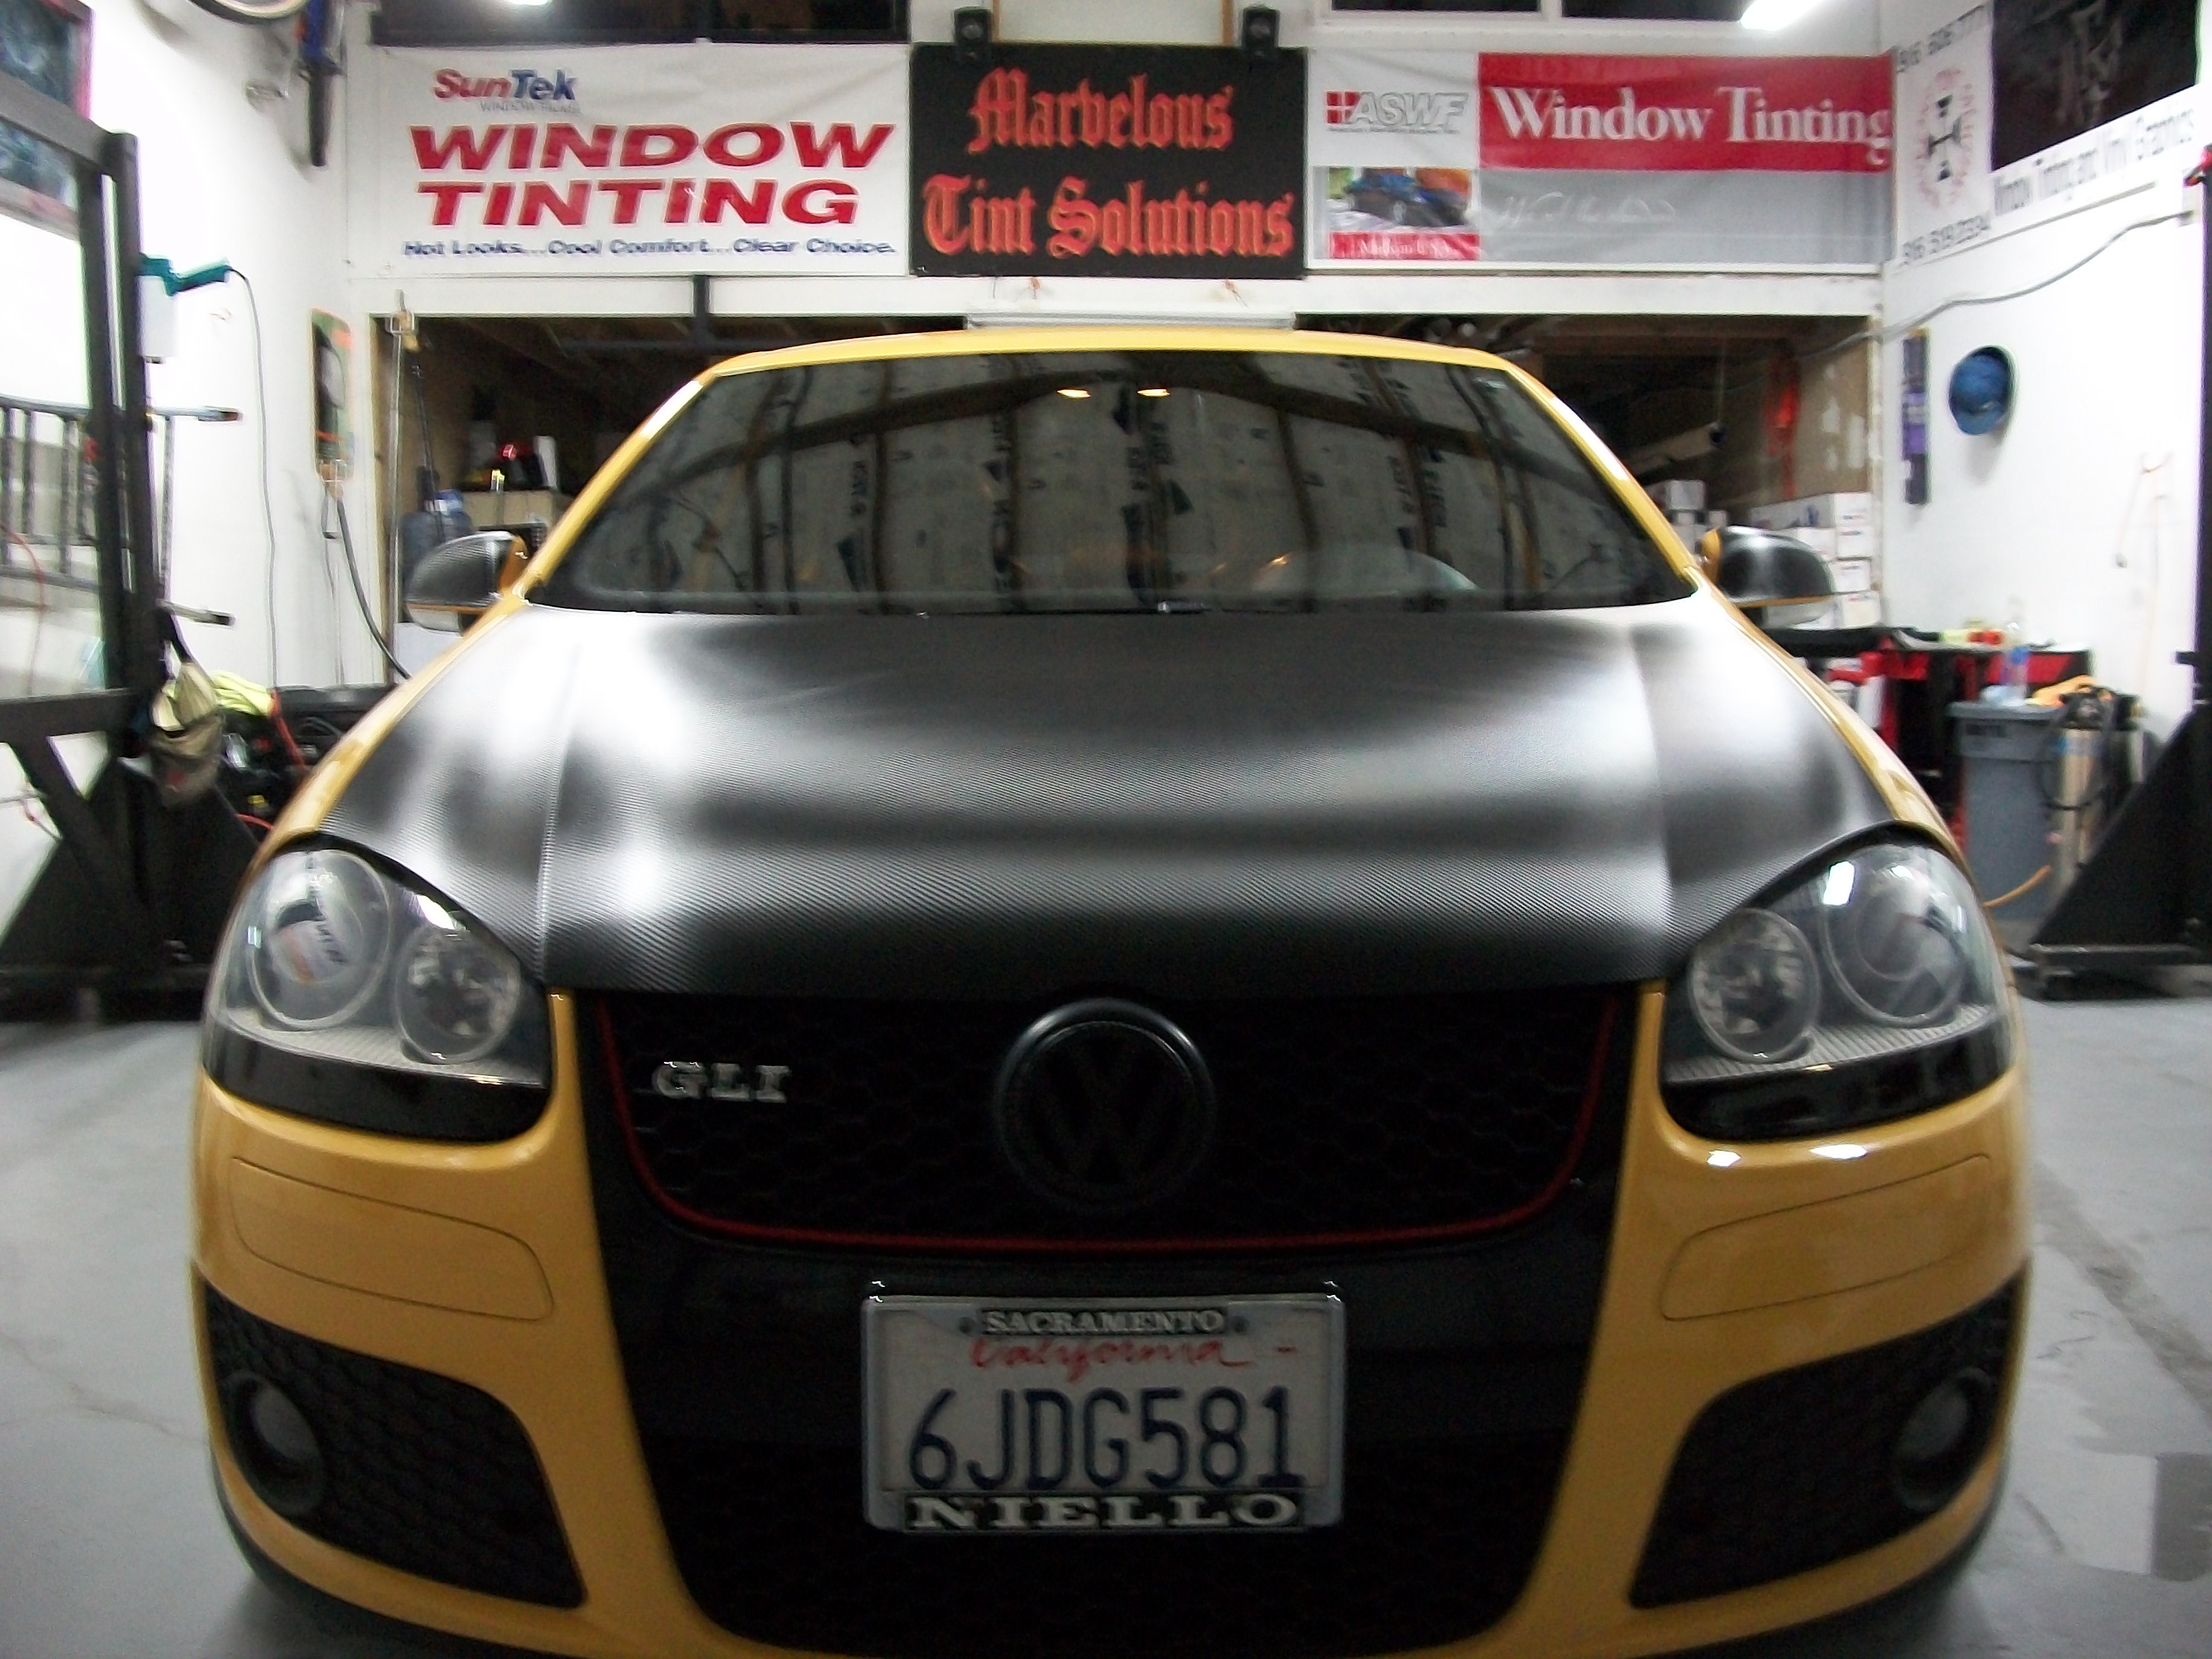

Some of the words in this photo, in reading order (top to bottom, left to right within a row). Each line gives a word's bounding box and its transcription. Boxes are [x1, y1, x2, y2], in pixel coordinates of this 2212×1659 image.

[434, 68, 578, 100] SunTek
[1344, 91, 1469, 126] ASWF
[1489, 86, 1713, 139] Window
[1714, 86, 1891, 165] Tinting
[410, 121, 896, 170] WINDOW
[418, 179, 860, 226] TINTING
[923, 174, 1037, 255] Tint
[404, 241, 444, 255] Hot
[651, 1061, 792, 1104] GLI
[986, 1309, 1225, 1334] SACRAMENTO
[908, 1387, 1306, 1490] 6JDG581
[908, 1494, 1298, 1529] NIELLO
